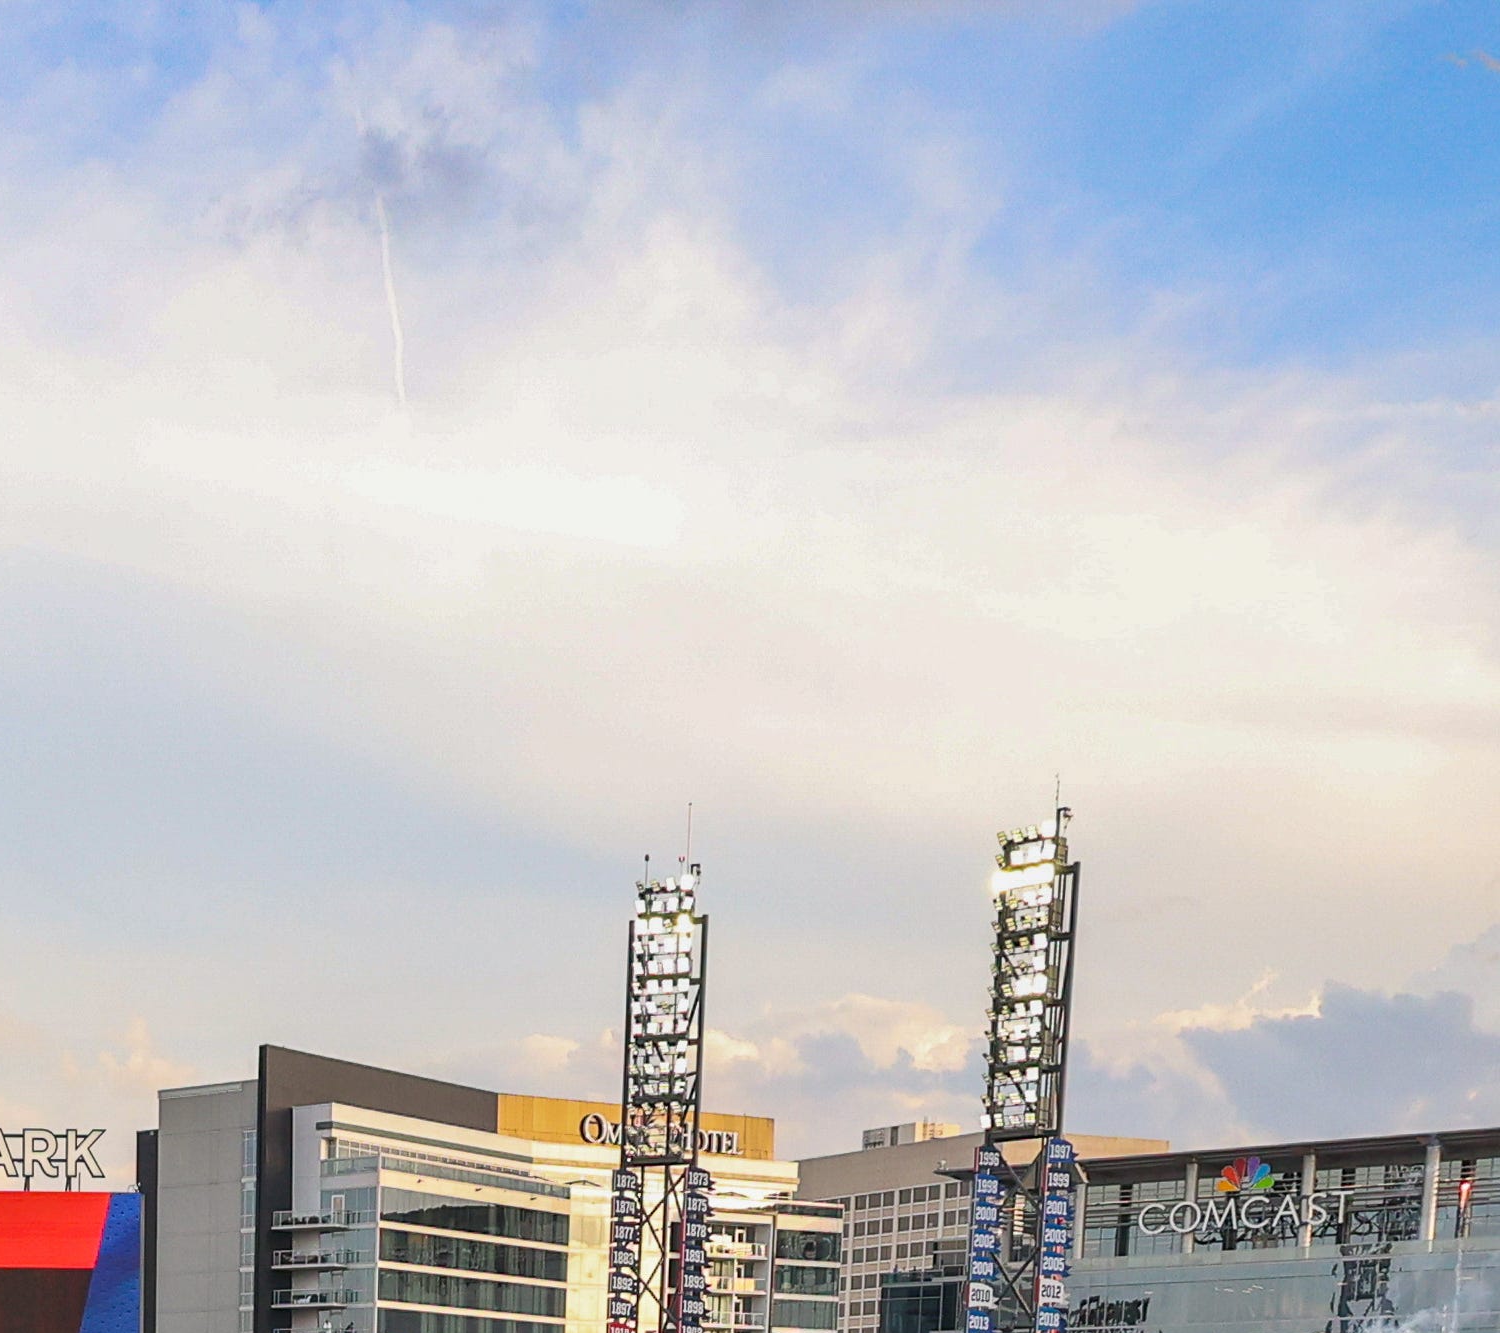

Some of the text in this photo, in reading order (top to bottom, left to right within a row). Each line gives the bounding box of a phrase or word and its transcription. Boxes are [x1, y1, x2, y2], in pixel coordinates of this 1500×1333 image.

[979, 1151, 1000, 1166] 1996
[1049, 1144, 1071, 1159] 1997
[616, 1174, 636, 1189] 1872
[688, 1172, 709, 1187] 1873
[1048, 1172, 1070, 1187] 1999
[615, 1200, 635, 1214] 1874
[687, 1198, 707, 1212] 1875
[1046, 1200, 1068, 1215] 2001
[975, 1206, 997, 1221] 2000
[1138, 1190, 1354, 1236] COMCAST
[614, 1225, 634, 1240] 1877
[1045, 1228, 1067, 1243] 2003
[973, 1234, 995, 1248] 2002
[972, 1262, 994, 1276] 2004
[1043, 1256, 1065, 1271] 2005
[612, 1276, 633, 1291] 1892
[970, 1289, 991, 1303] 2010
[1041, 1284, 1063, 1299] 2012
[611, 1301, 631, 1316] 1897
[969, 1315, 990, 1330] 2013
